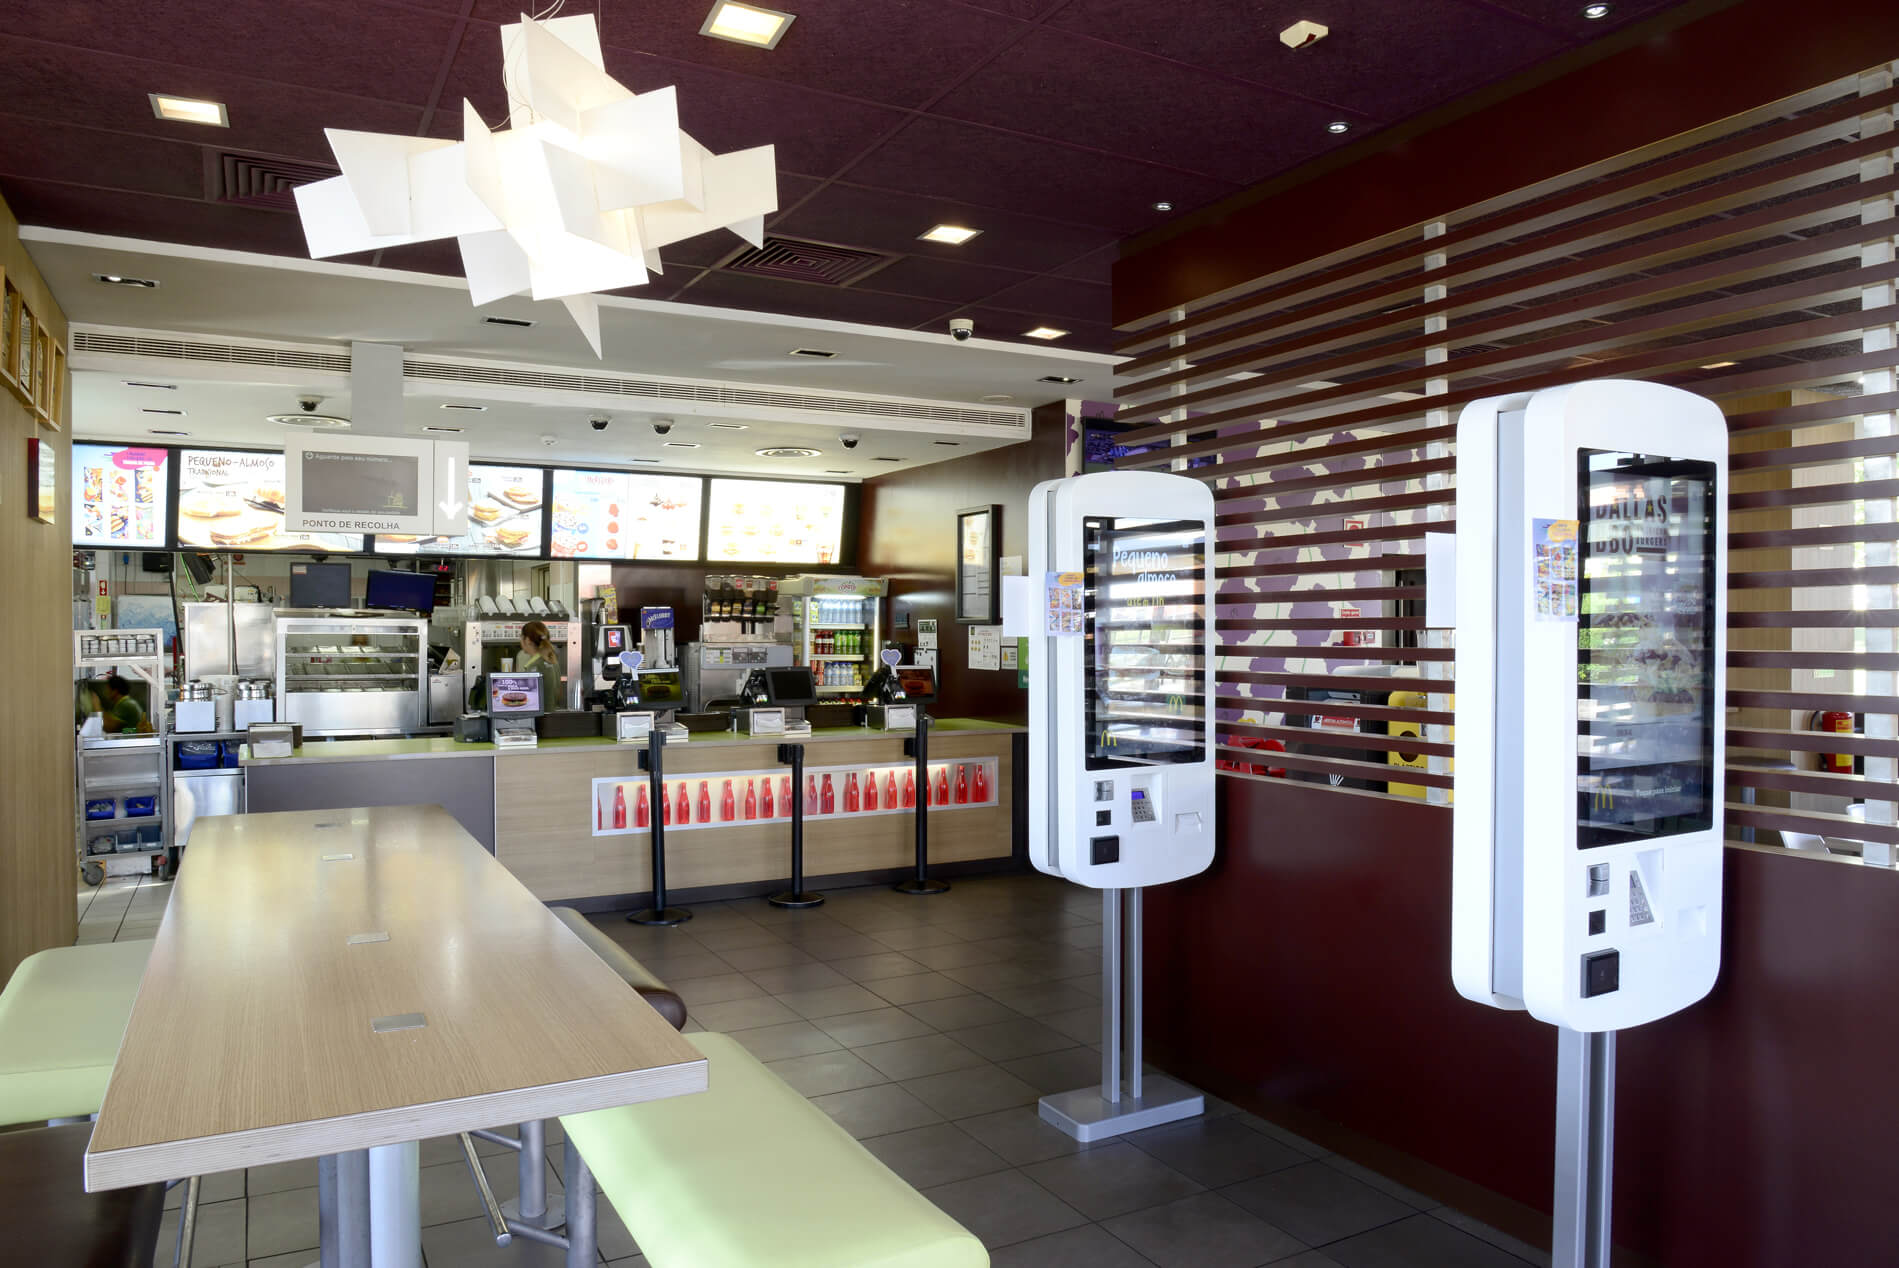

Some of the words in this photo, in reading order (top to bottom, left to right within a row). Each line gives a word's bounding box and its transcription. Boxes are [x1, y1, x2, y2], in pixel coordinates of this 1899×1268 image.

[1596, 495, 1667, 524] DALLAS
[302, 519, 336, 528] PONTO
[338, 520, 351, 529] DE
[354, 521, 401, 530] RECOLHA
[1113, 545, 1169, 575] Pequeno
